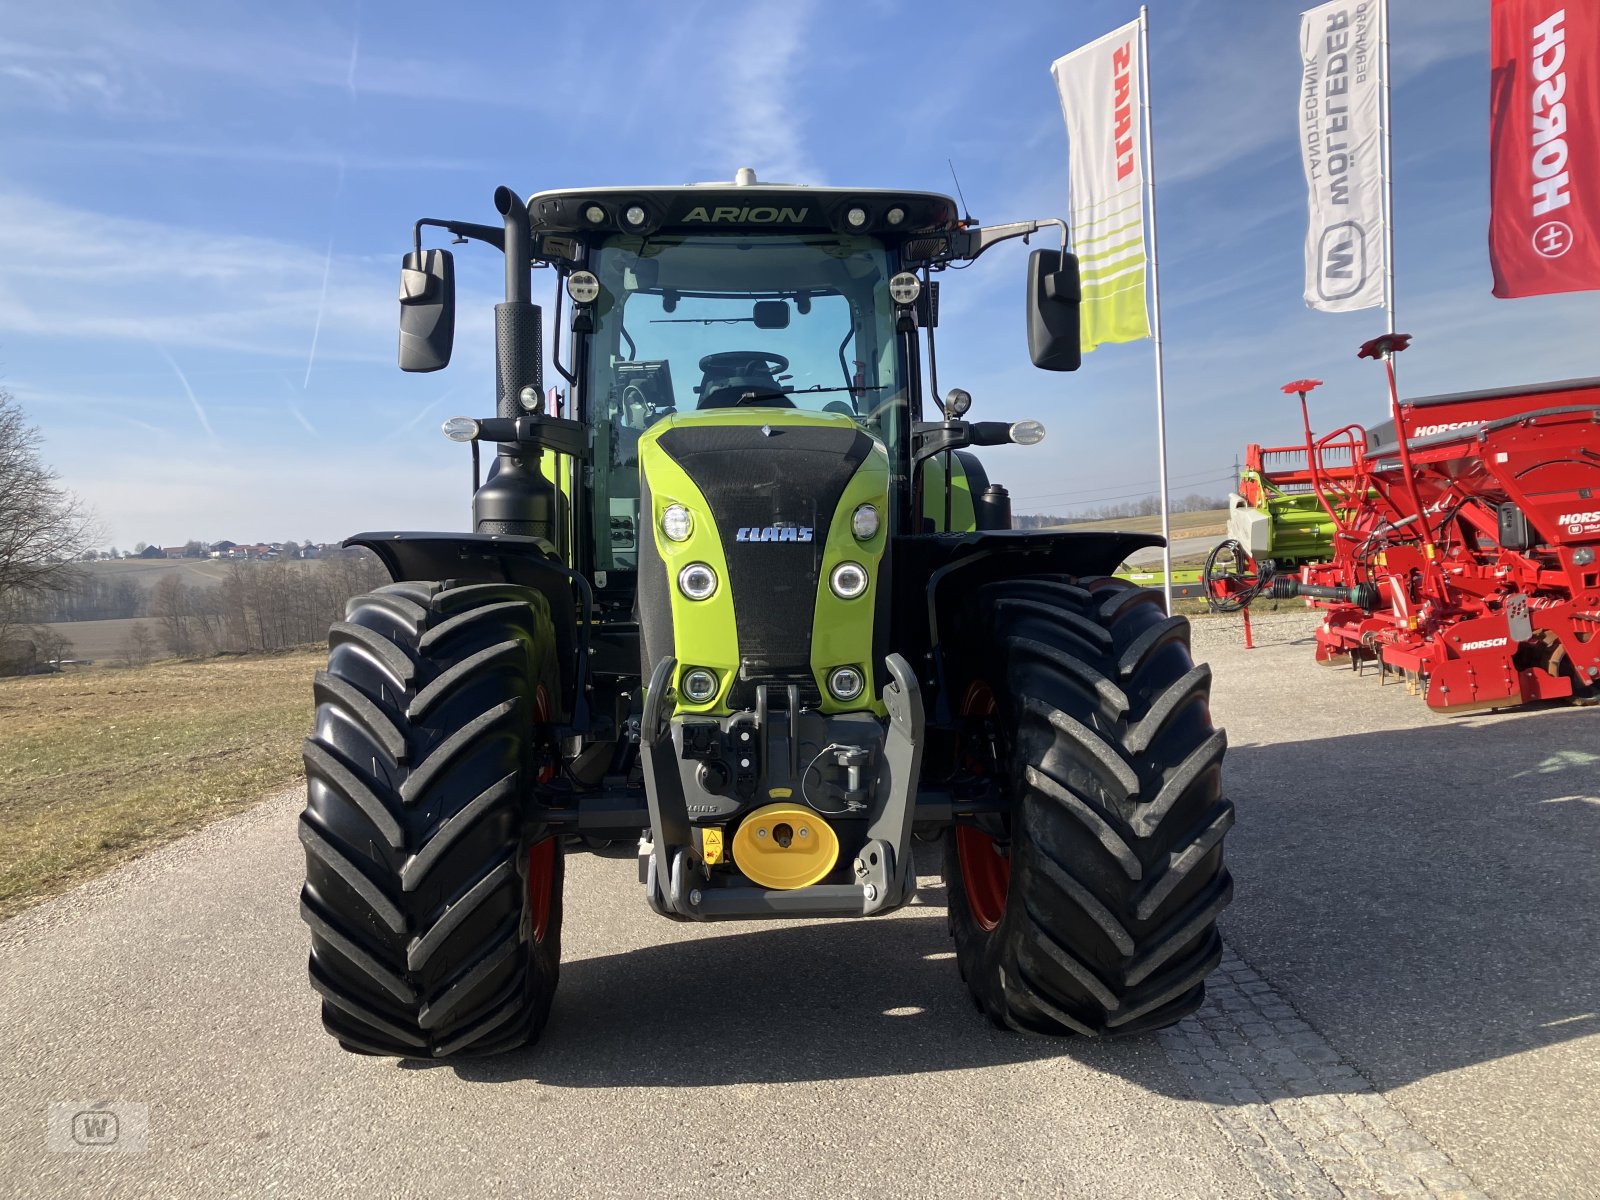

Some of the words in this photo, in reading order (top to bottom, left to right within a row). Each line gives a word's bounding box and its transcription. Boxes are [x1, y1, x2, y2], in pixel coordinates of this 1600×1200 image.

[680, 206, 809, 223] ARION
[736, 527, 813, 542] CLAAS
[1461, 637, 1508, 651] HORSCH
